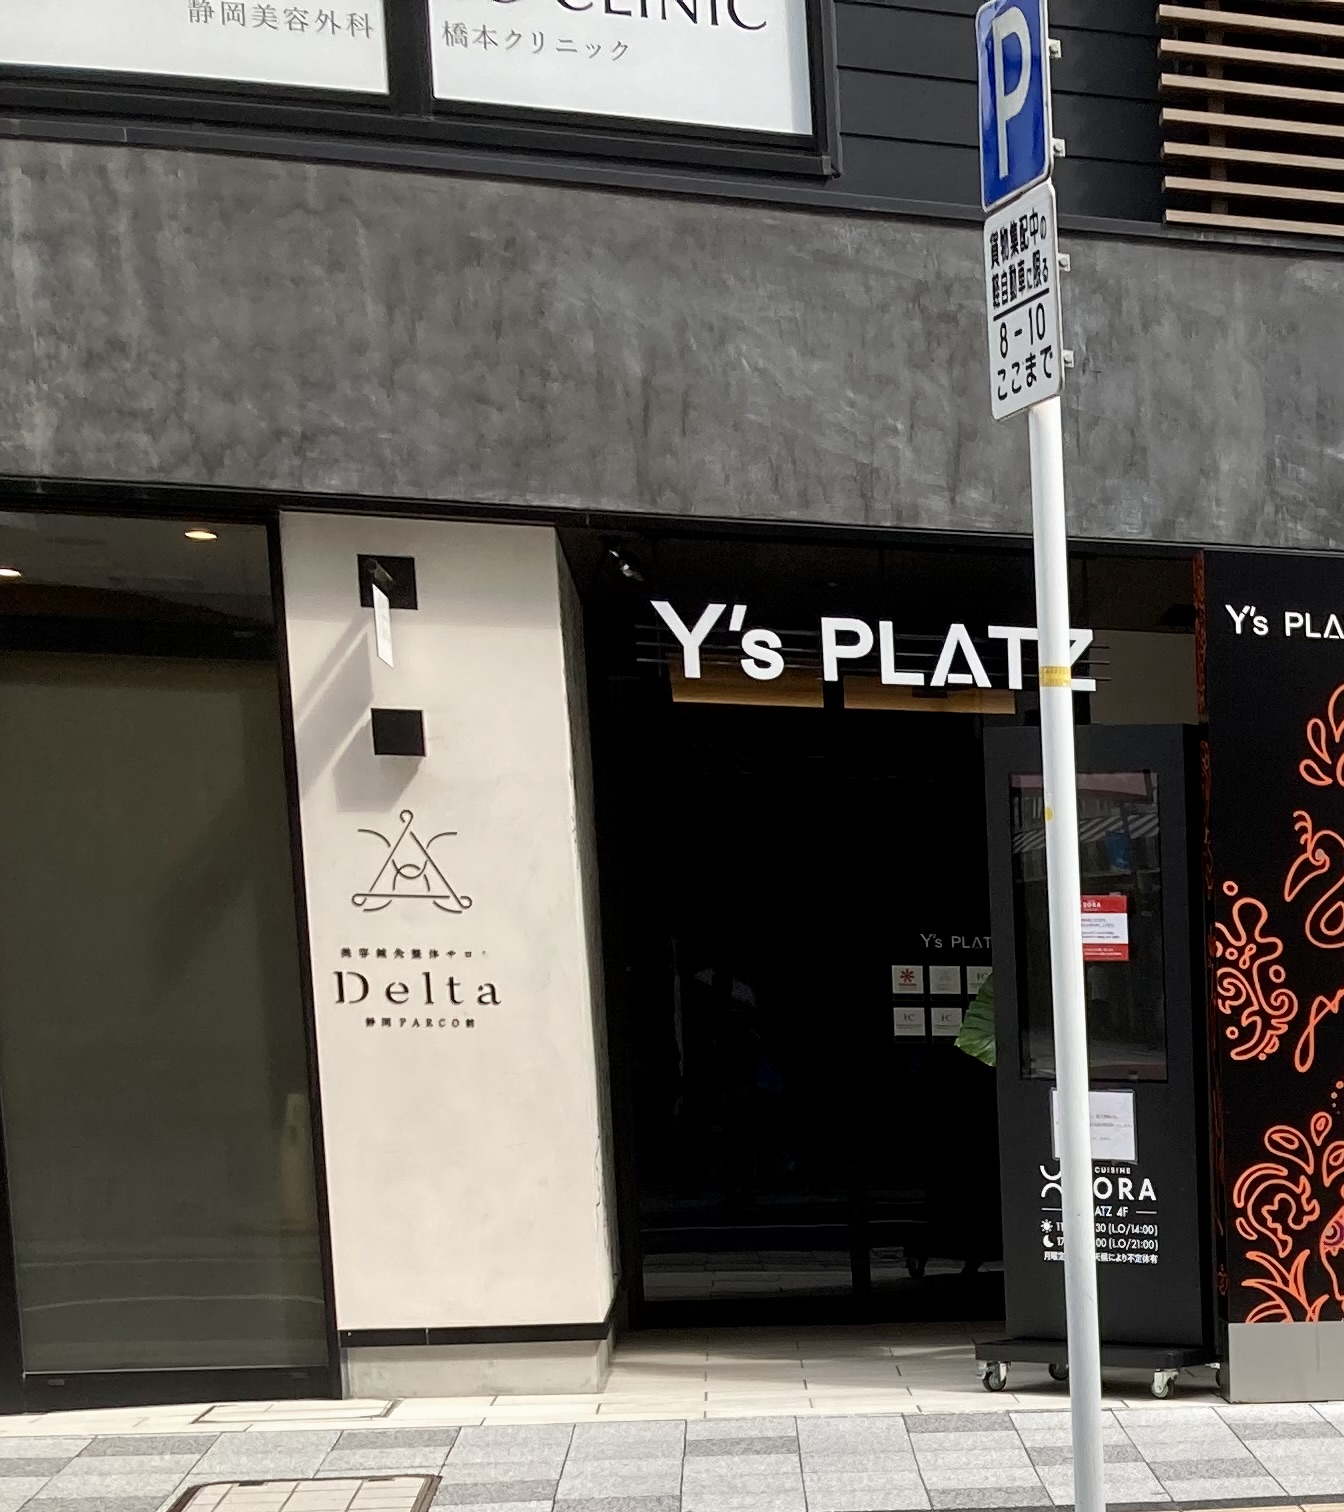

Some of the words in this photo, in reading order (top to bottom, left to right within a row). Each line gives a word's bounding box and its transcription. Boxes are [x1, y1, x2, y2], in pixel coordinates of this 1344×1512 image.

[187, 0, 375, 40] 静岡美容外科
[443, 20, 629, 62] 橋本クリニック
[992, 6, 1032, 179] P
[997, 345, 1054, 401] ここまで
[1225, 604, 1269, 636] Y's
[650, 600, 785, 681] Y's
[920, 933, 943, 948] Y's
[951, 935, 992, 949] PLAT
[333, 970, 502, 1006] Delta
[1093, 1176, 1157, 1201] ORA
[1116, 1206, 1129, 1218] 4F
